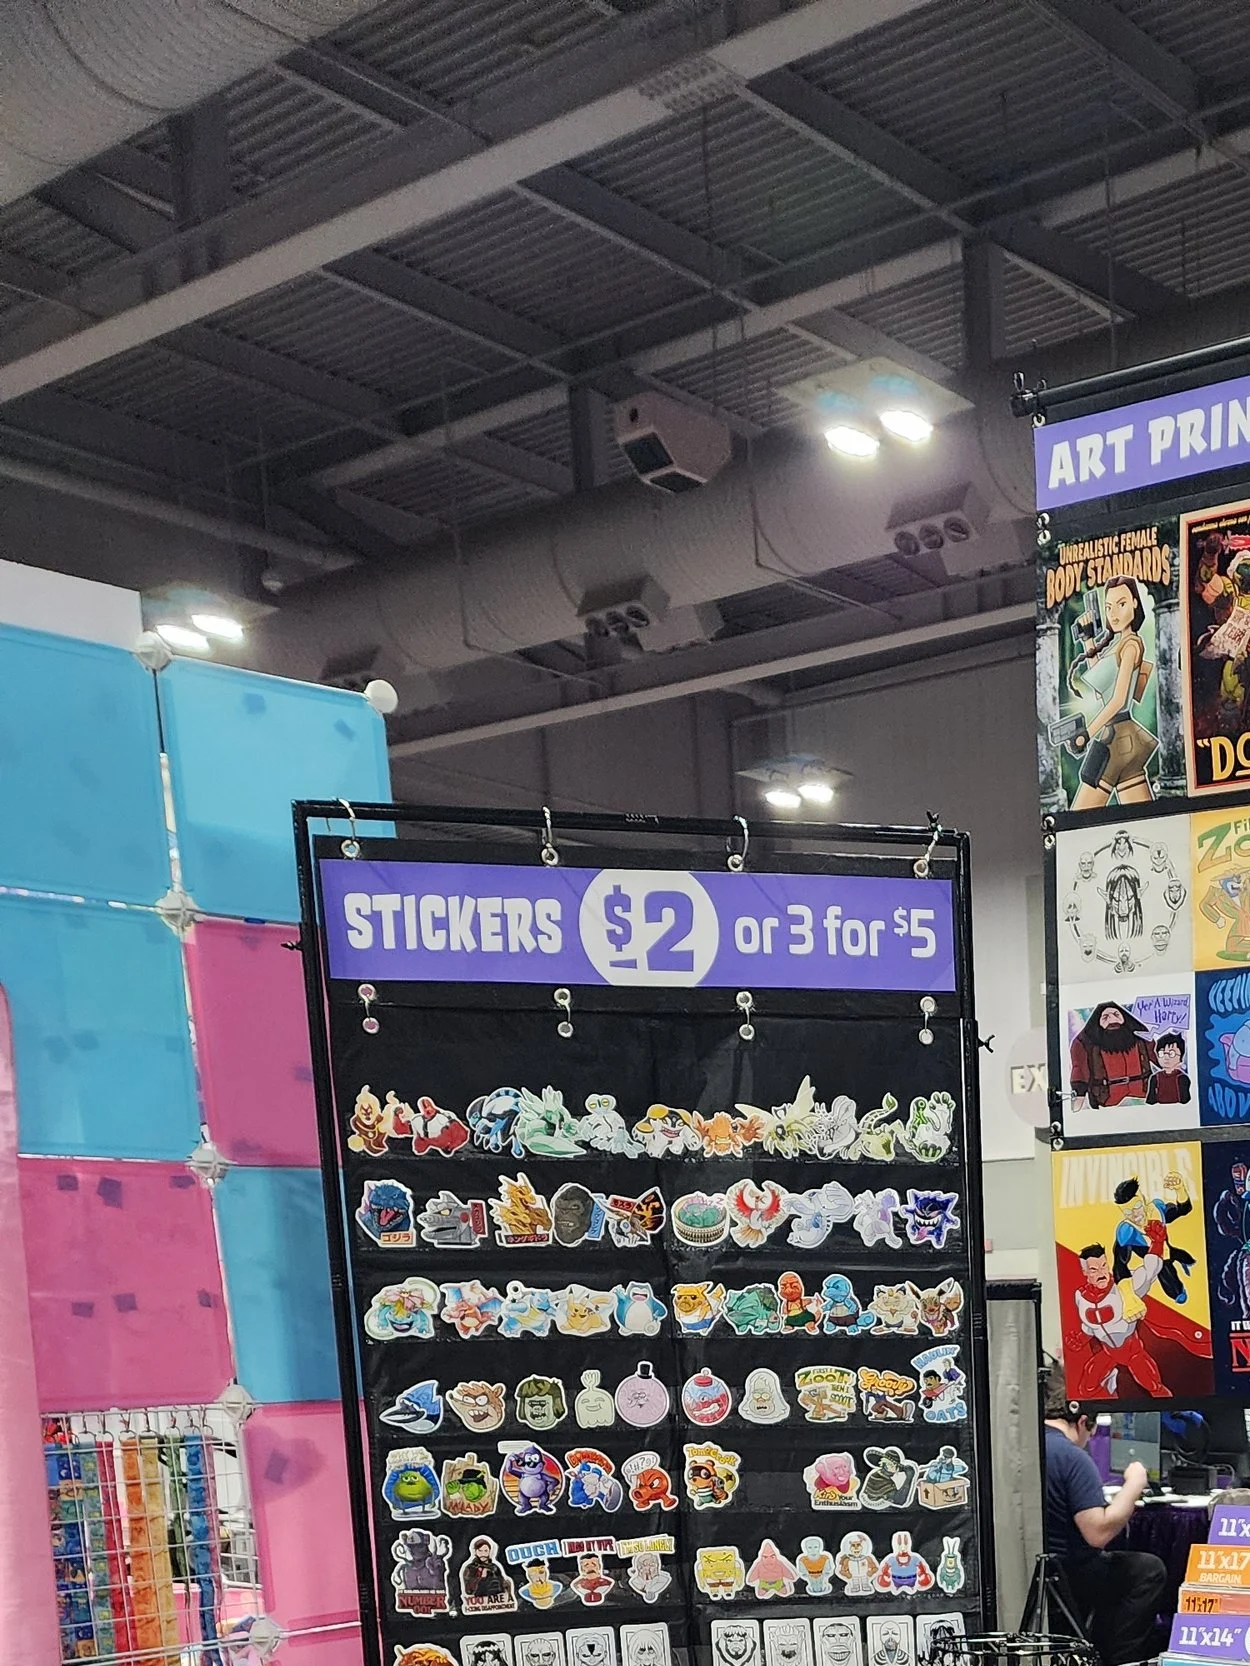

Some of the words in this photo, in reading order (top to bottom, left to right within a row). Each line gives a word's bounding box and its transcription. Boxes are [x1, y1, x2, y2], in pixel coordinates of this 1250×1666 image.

[1048, 424, 1134, 490] ART
[1058, 534, 1118, 564] UNREALISTIC
[1120, 527, 1158, 555] FEMALE
[1046, 563, 1083, 609] BODY
[1087, 545, 1172, 587] STANDARDS
[342, 890, 563, 955] STICKERS
[602, 882, 698, 973] $2
[733, 916, 781, 956] or
[786, 904, 815, 956] 3
[824, 904, 887, 957] for
[892, 906, 938, 960] $5
[1154, 1008, 1187, 1024] Harry!
[858, 1368, 916, 1398] Groovy
[925, 1402, 967, 1421] OATS
[507, 1541, 561, 1562] OUCH
[1199, 1573, 1242, 1585] BARGAIN
[398, 1594, 447, 1609] NUMBER
[465, 1597, 485, 1606] YOU
[486, 1595, 505, 1604] ARE
[1178, 1626, 1243, 1648] 11"x14"
